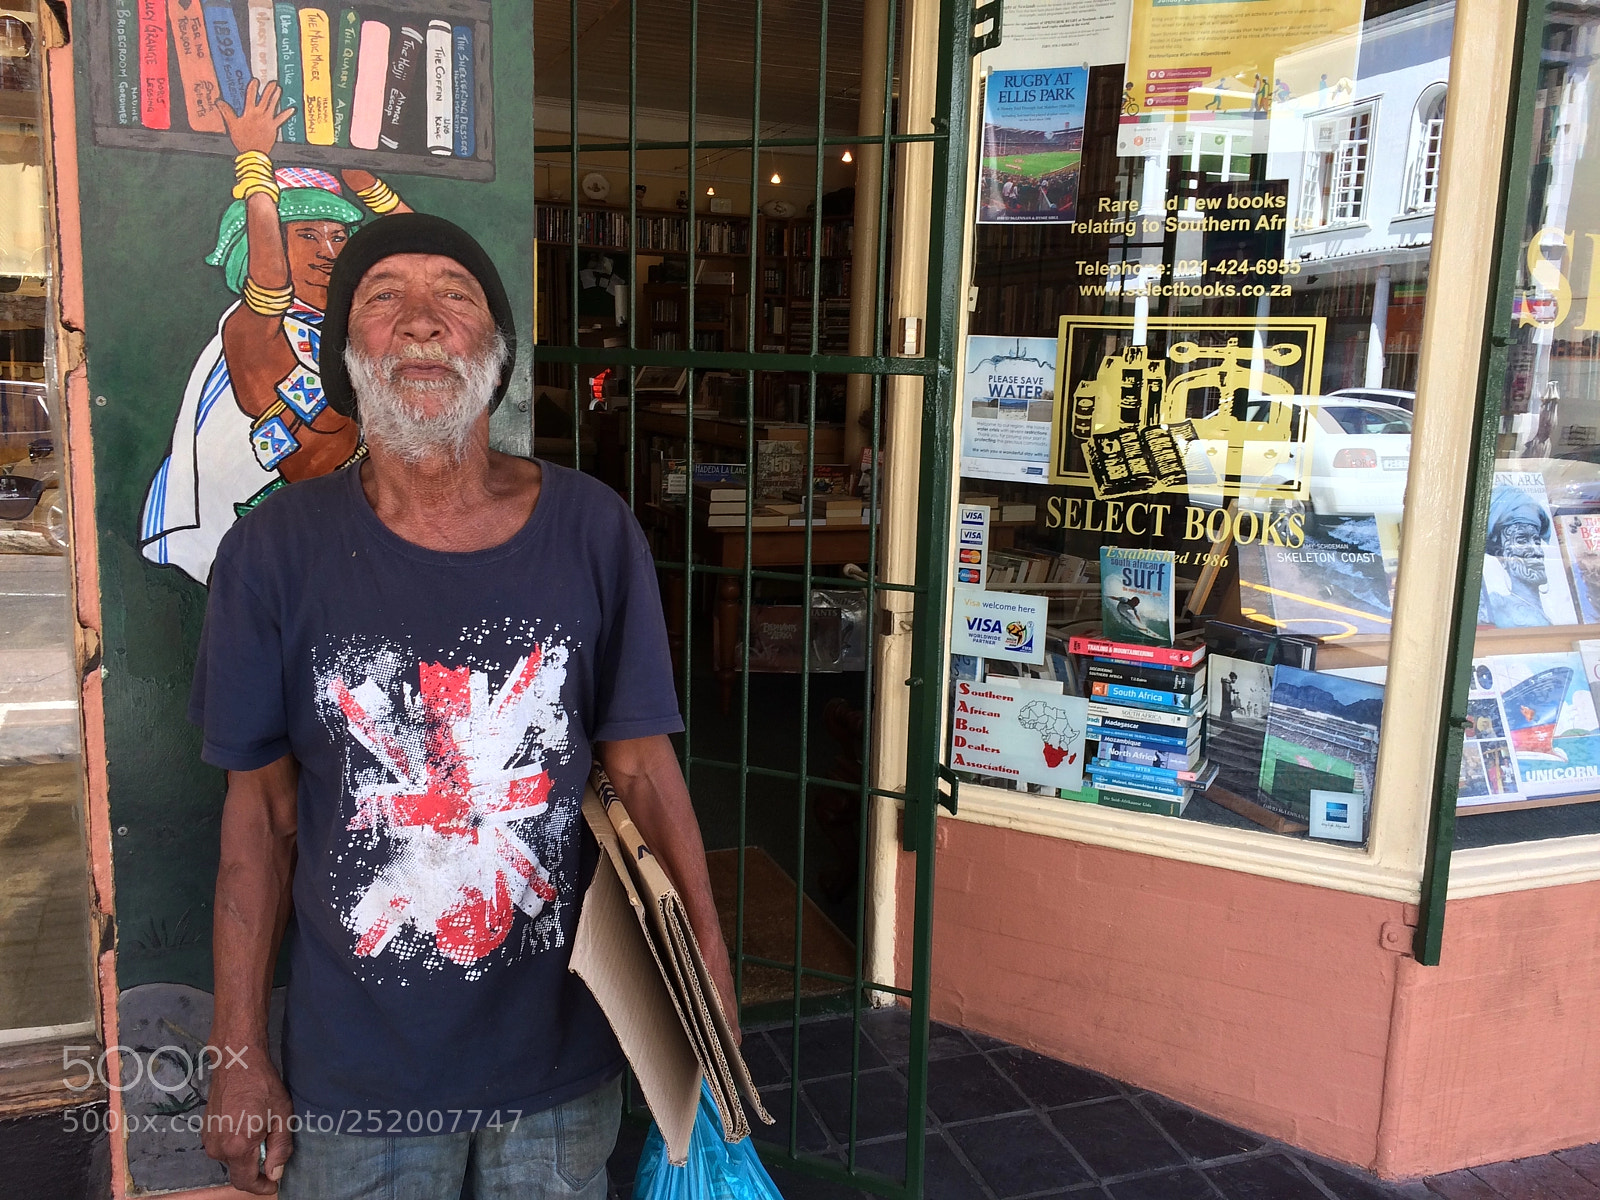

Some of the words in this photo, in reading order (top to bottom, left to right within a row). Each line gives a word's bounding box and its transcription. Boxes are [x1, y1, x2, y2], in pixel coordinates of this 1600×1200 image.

[280, 14, 292, 35] Like
[307, 12, 324, 31] THE
[117, 9, 131, 77] BRIDEGROOM
[144, 24, 163, 65] GRANGE
[178, 16, 192, 56] REASON
[282, 38, 294, 60] unto
[401, 40, 415, 60] The
[285, 63, 295, 86] Like
[337, 47, 354, 89] QUARRY
[435, 65, 446, 102] COFFIN
[1004, 74, 1051, 88] RUGBY
[1054, 72, 1073, 86] AT
[118, 81, 129, 124] GORDIMER
[998, 90, 1036, 104] ELLIS
[1040, 87, 1076, 102] PARK
[306, 94, 317, 134] BOSMAN
[391, 91, 407, 126] Ahmed
[1098, 197, 1139, 213] Rare
[1227, 193, 1286, 211] books
[1071, 218, 1136, 237] relating
[1142, 217, 1159, 233] to
[1165, 214, 1250, 233] Southern
[1255, 213, 1314, 232] Afrca
[1177, 258, 1301, 275] 021-424-6955
[988, 374, 1018, 384] PLEASE
[1021, 376, 1044, 386] SAVE
[988, 383, 1043, 399] WATER
[694, 463, 720, 475] HADEDA
[721, 464, 729, 475] LA
[1518, 474, 1545, 486] ARK
[965, 511, 983, 521] VISA
[1045, 495, 1171, 537] SELECT
[1184, 505, 1307, 549] BOOKS
[964, 531, 982, 540] VISA
[1106, 544, 1187, 566] Established
[1192, 550, 1230, 568] 1986
[1277, 552, 1335, 563] SKELETON
[1341, 552, 1376, 563] COAST
[1122, 563, 1165, 591] surf
[964, 597, 980, 608] Visa
[982, 600, 1016, 612] welcome
[1018, 604, 1036, 614] here
[964, 615, 1002, 634] VISA
[968, 632, 1001, 642] WORLDWIDE
[972, 637, 996, 646] PARTNER
[959, 683, 1014, 702] Southern
[1113, 687, 1136, 699] South
[1139, 689, 1163, 702] Africa
[957, 701, 1001, 718] African
[955, 718, 989, 735] Book
[1104, 718, 1139, 730] Madagascar
[954, 735, 1000, 754] Dealers
[1104, 736, 1141, 747] Mozambique
[1108, 746, 1131, 759] North
[1132, 751, 1158, 762] Africa
[953, 753, 1020, 775] Association
[1525, 765, 1598, 782] UNICORN
